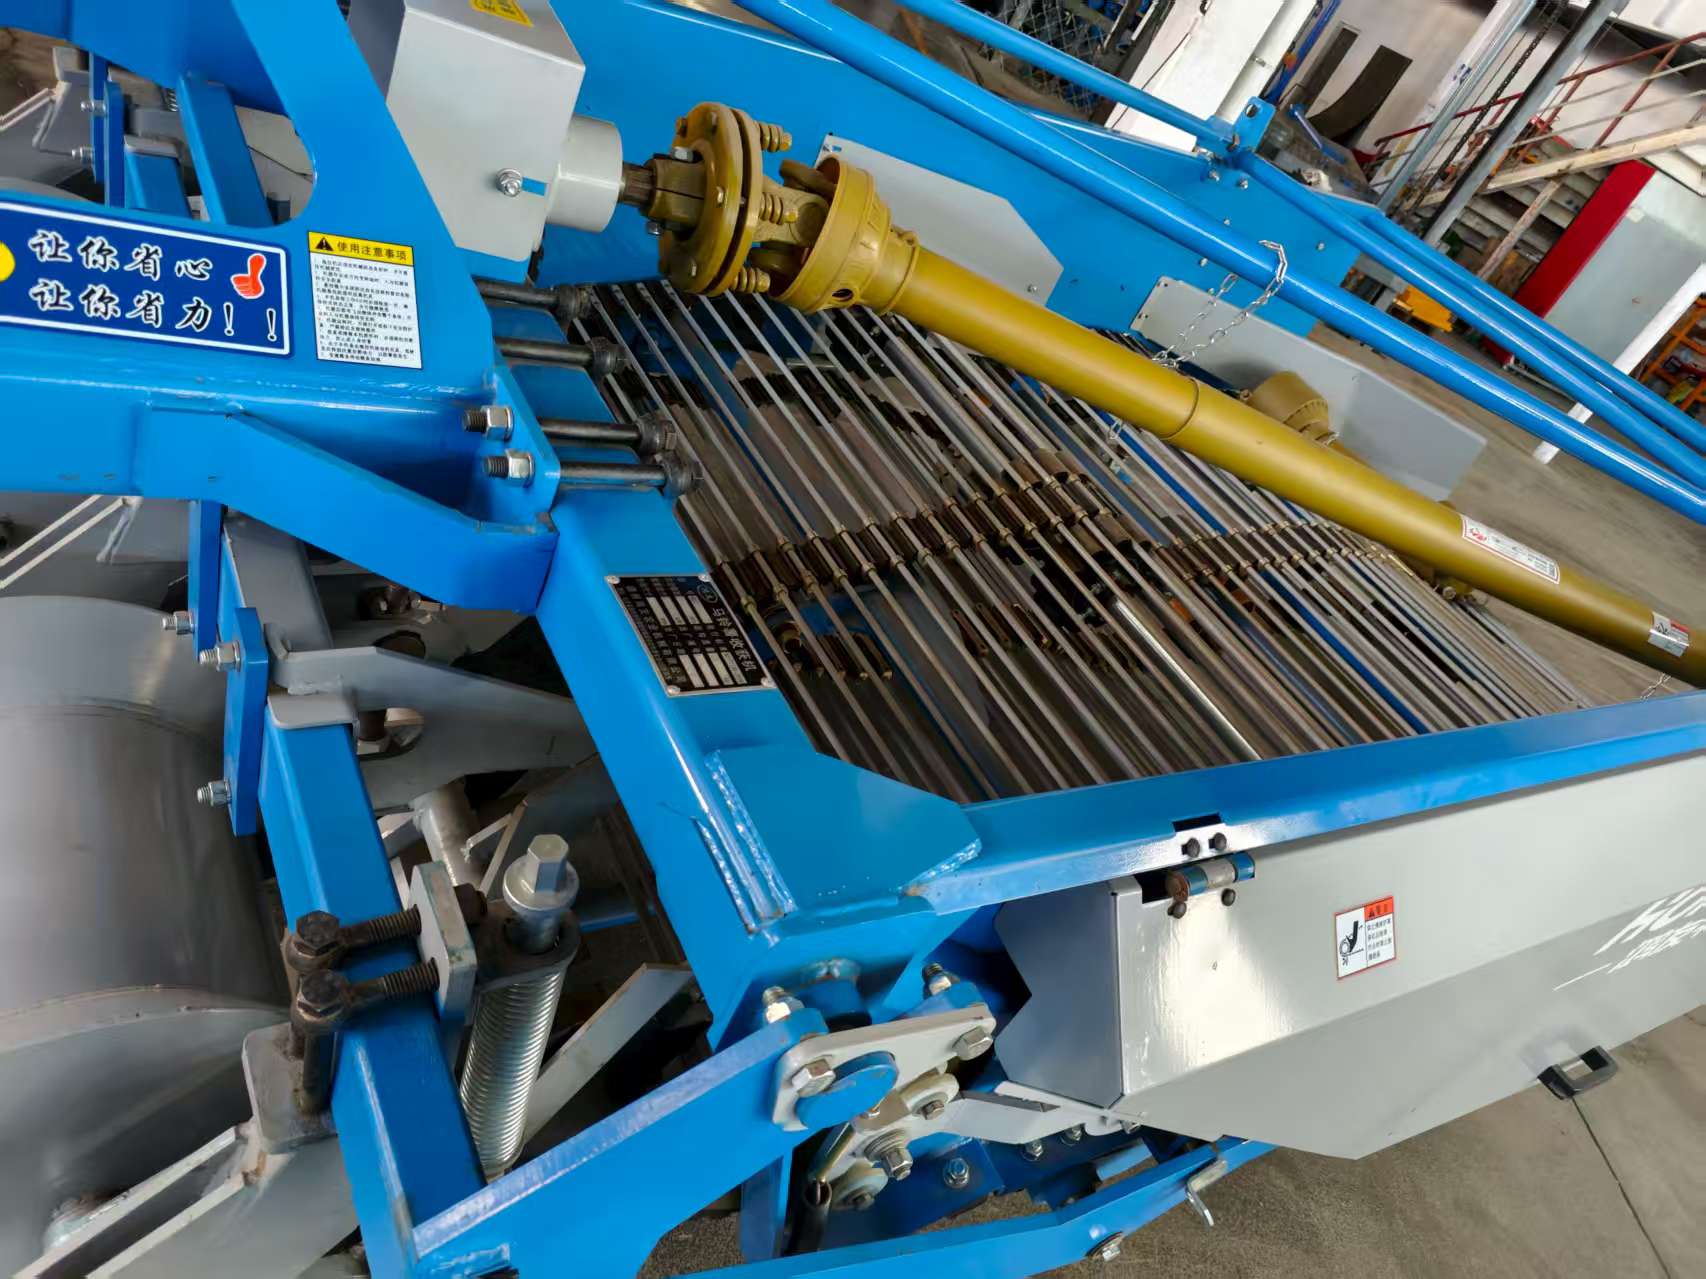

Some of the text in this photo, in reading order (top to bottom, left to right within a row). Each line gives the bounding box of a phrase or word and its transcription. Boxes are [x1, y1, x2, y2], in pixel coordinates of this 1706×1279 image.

[29, 230, 212, 280] 让你省心
[337, 240, 408, 261] 使用注意事项
